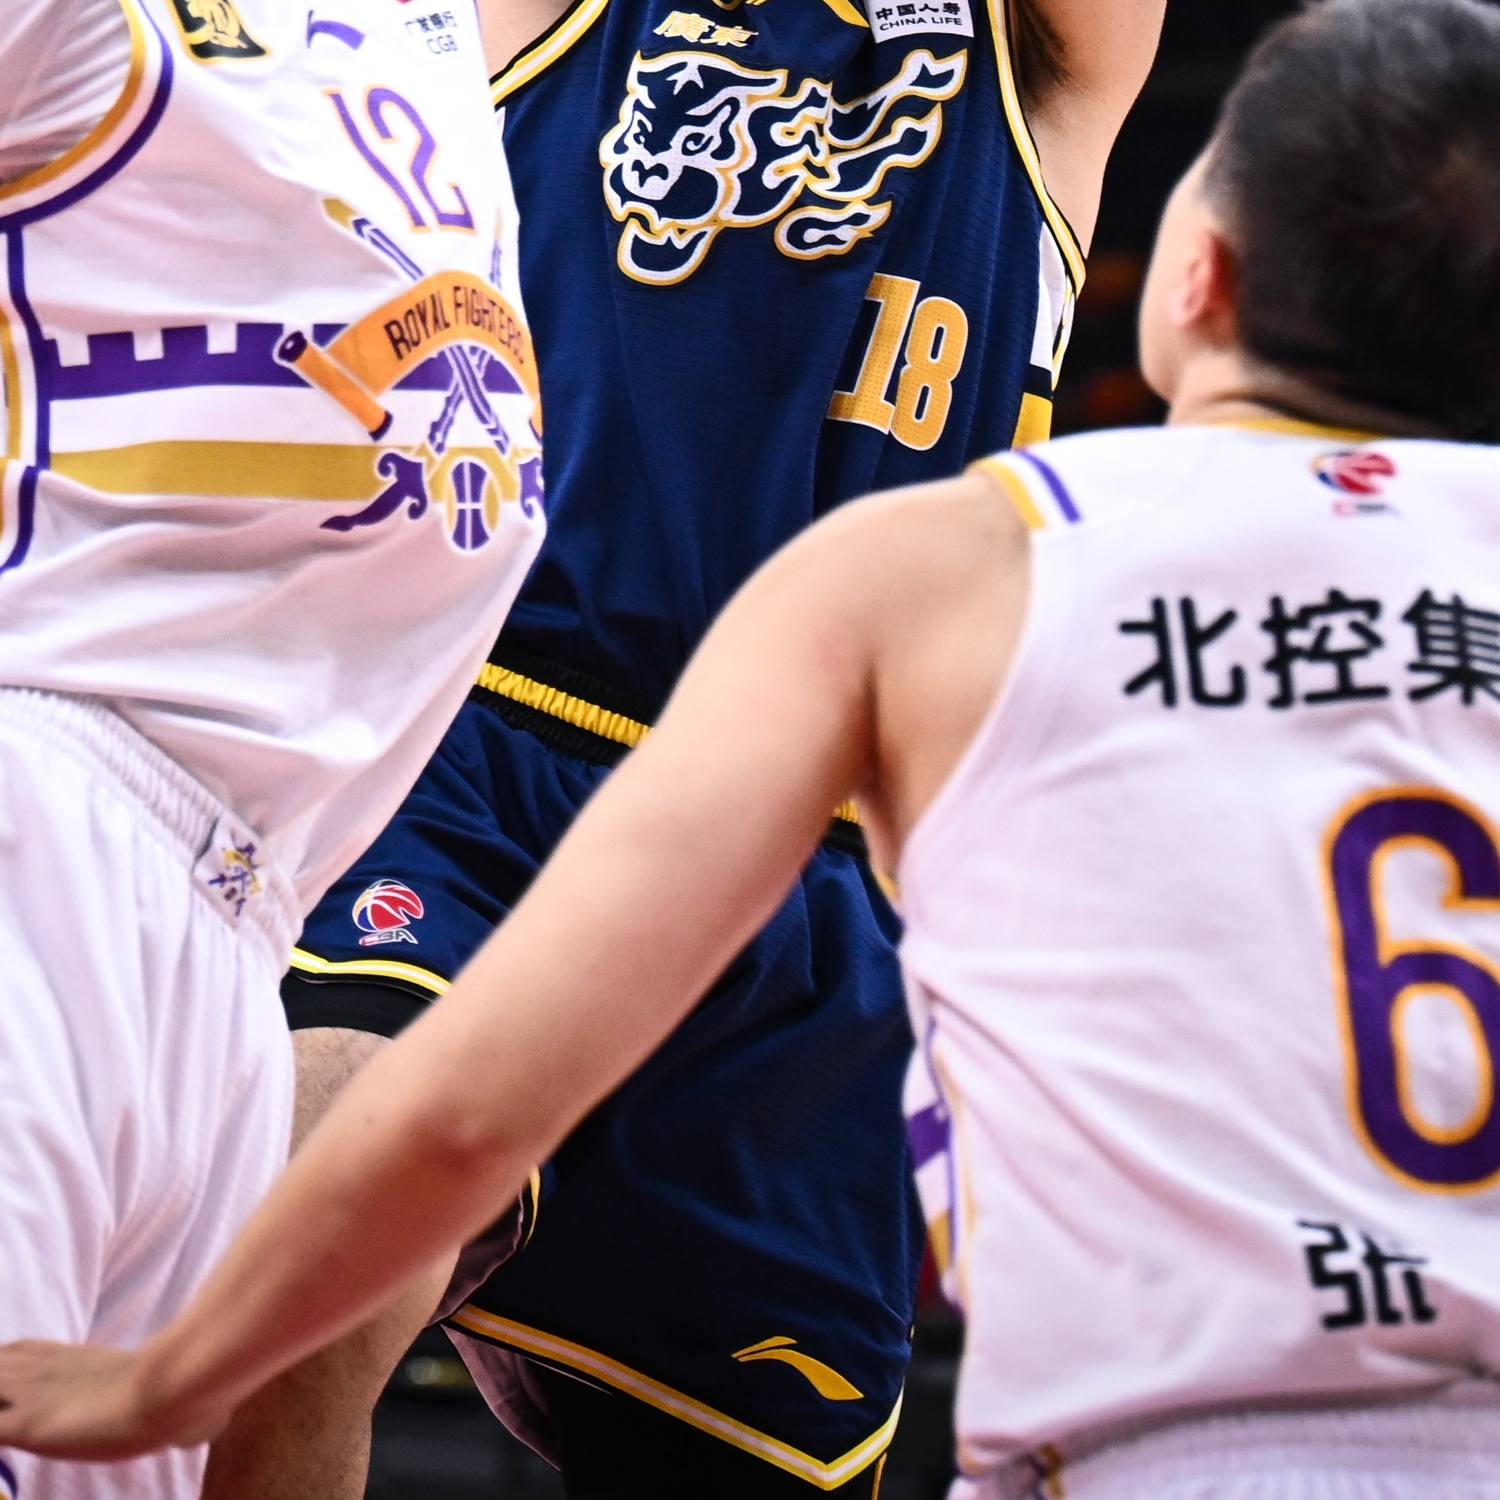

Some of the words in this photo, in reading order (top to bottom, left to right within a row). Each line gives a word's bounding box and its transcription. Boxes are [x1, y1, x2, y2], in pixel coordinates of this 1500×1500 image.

[426, 34, 458, 55] CGB
[879, 16, 927, 31] CHINA
[931, 16, 963, 26] LIFE
[322, 83, 478, 235] 12
[384, 290, 451, 361] ROYAL
[826, 274, 969, 451] 18
